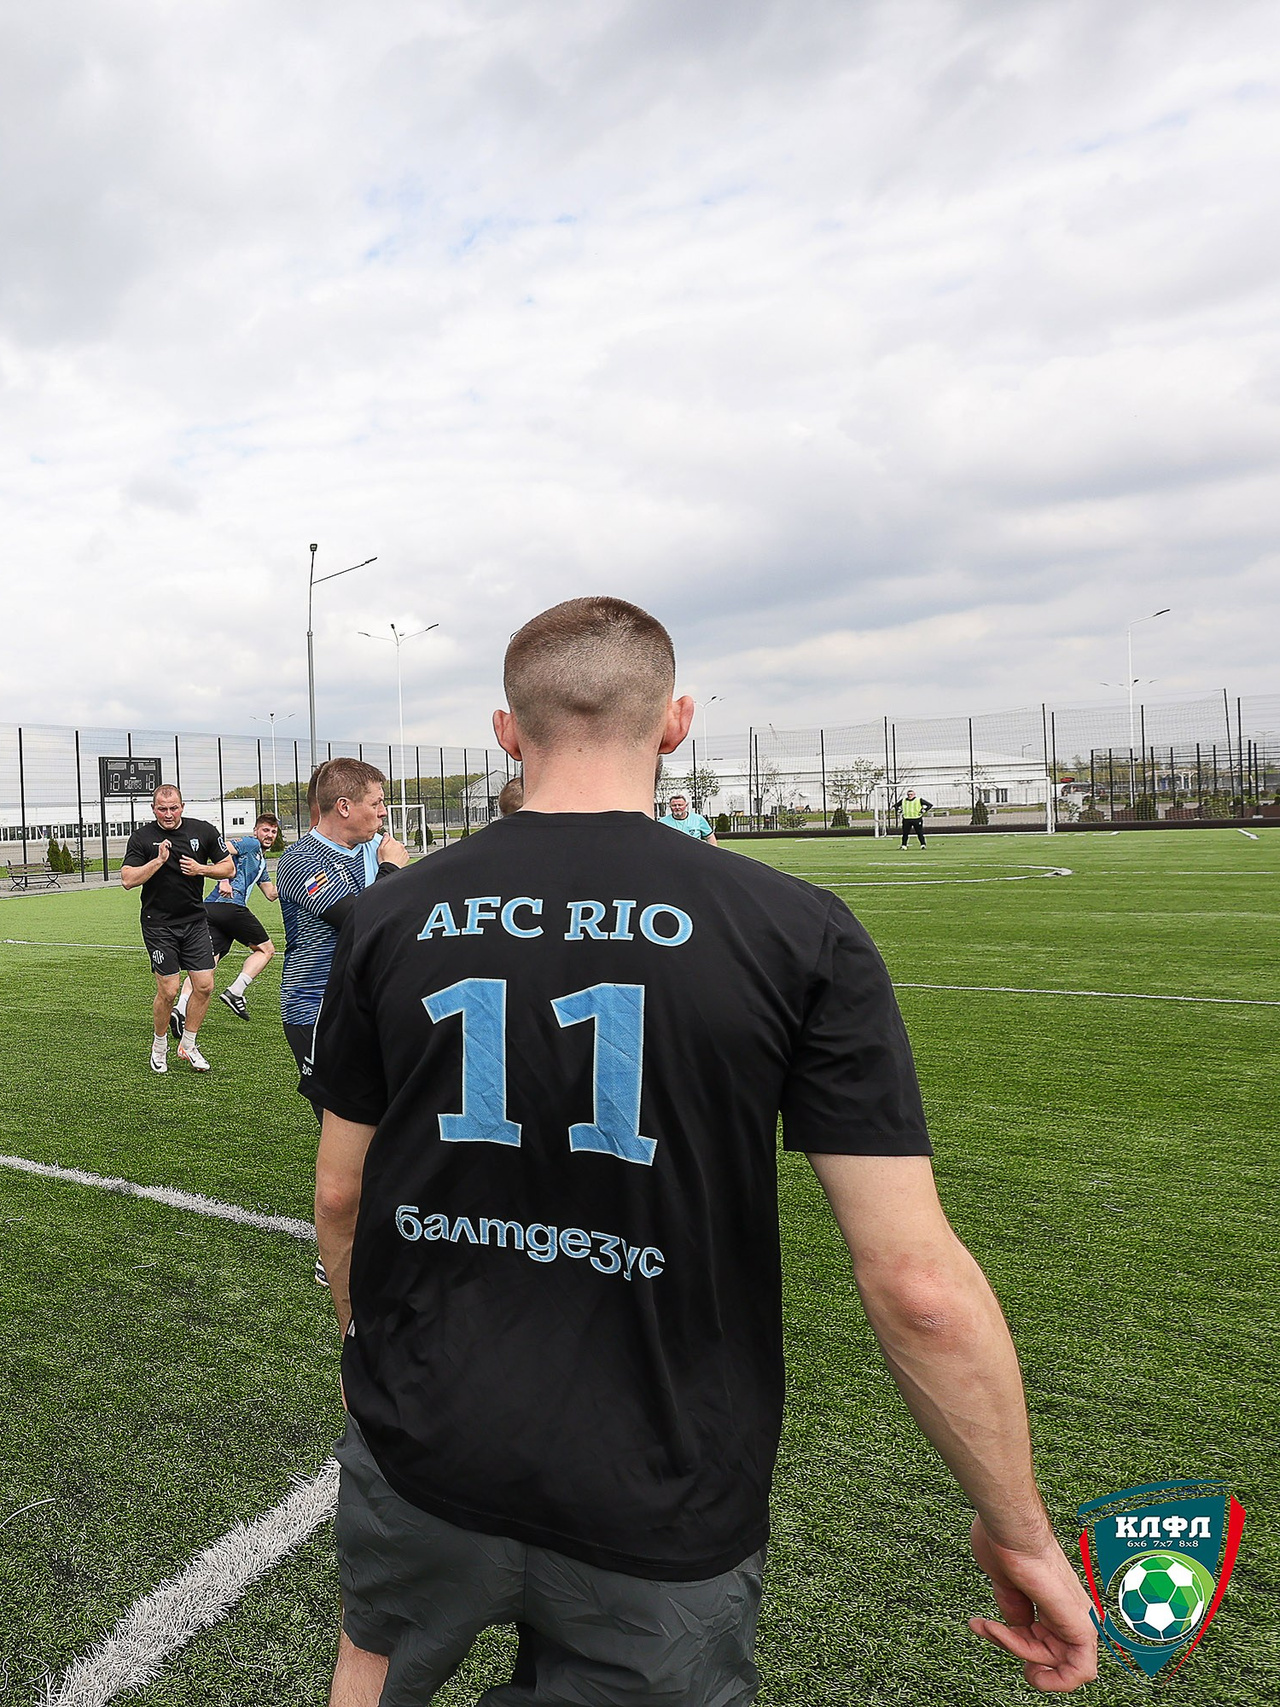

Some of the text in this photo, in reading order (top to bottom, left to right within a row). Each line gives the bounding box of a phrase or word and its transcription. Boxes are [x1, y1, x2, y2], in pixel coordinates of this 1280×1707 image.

[417, 896, 694, 947] AFC RIO
[421, 977, 659, 1167] 11
[395, 1204, 666, 1281] балтдезус
